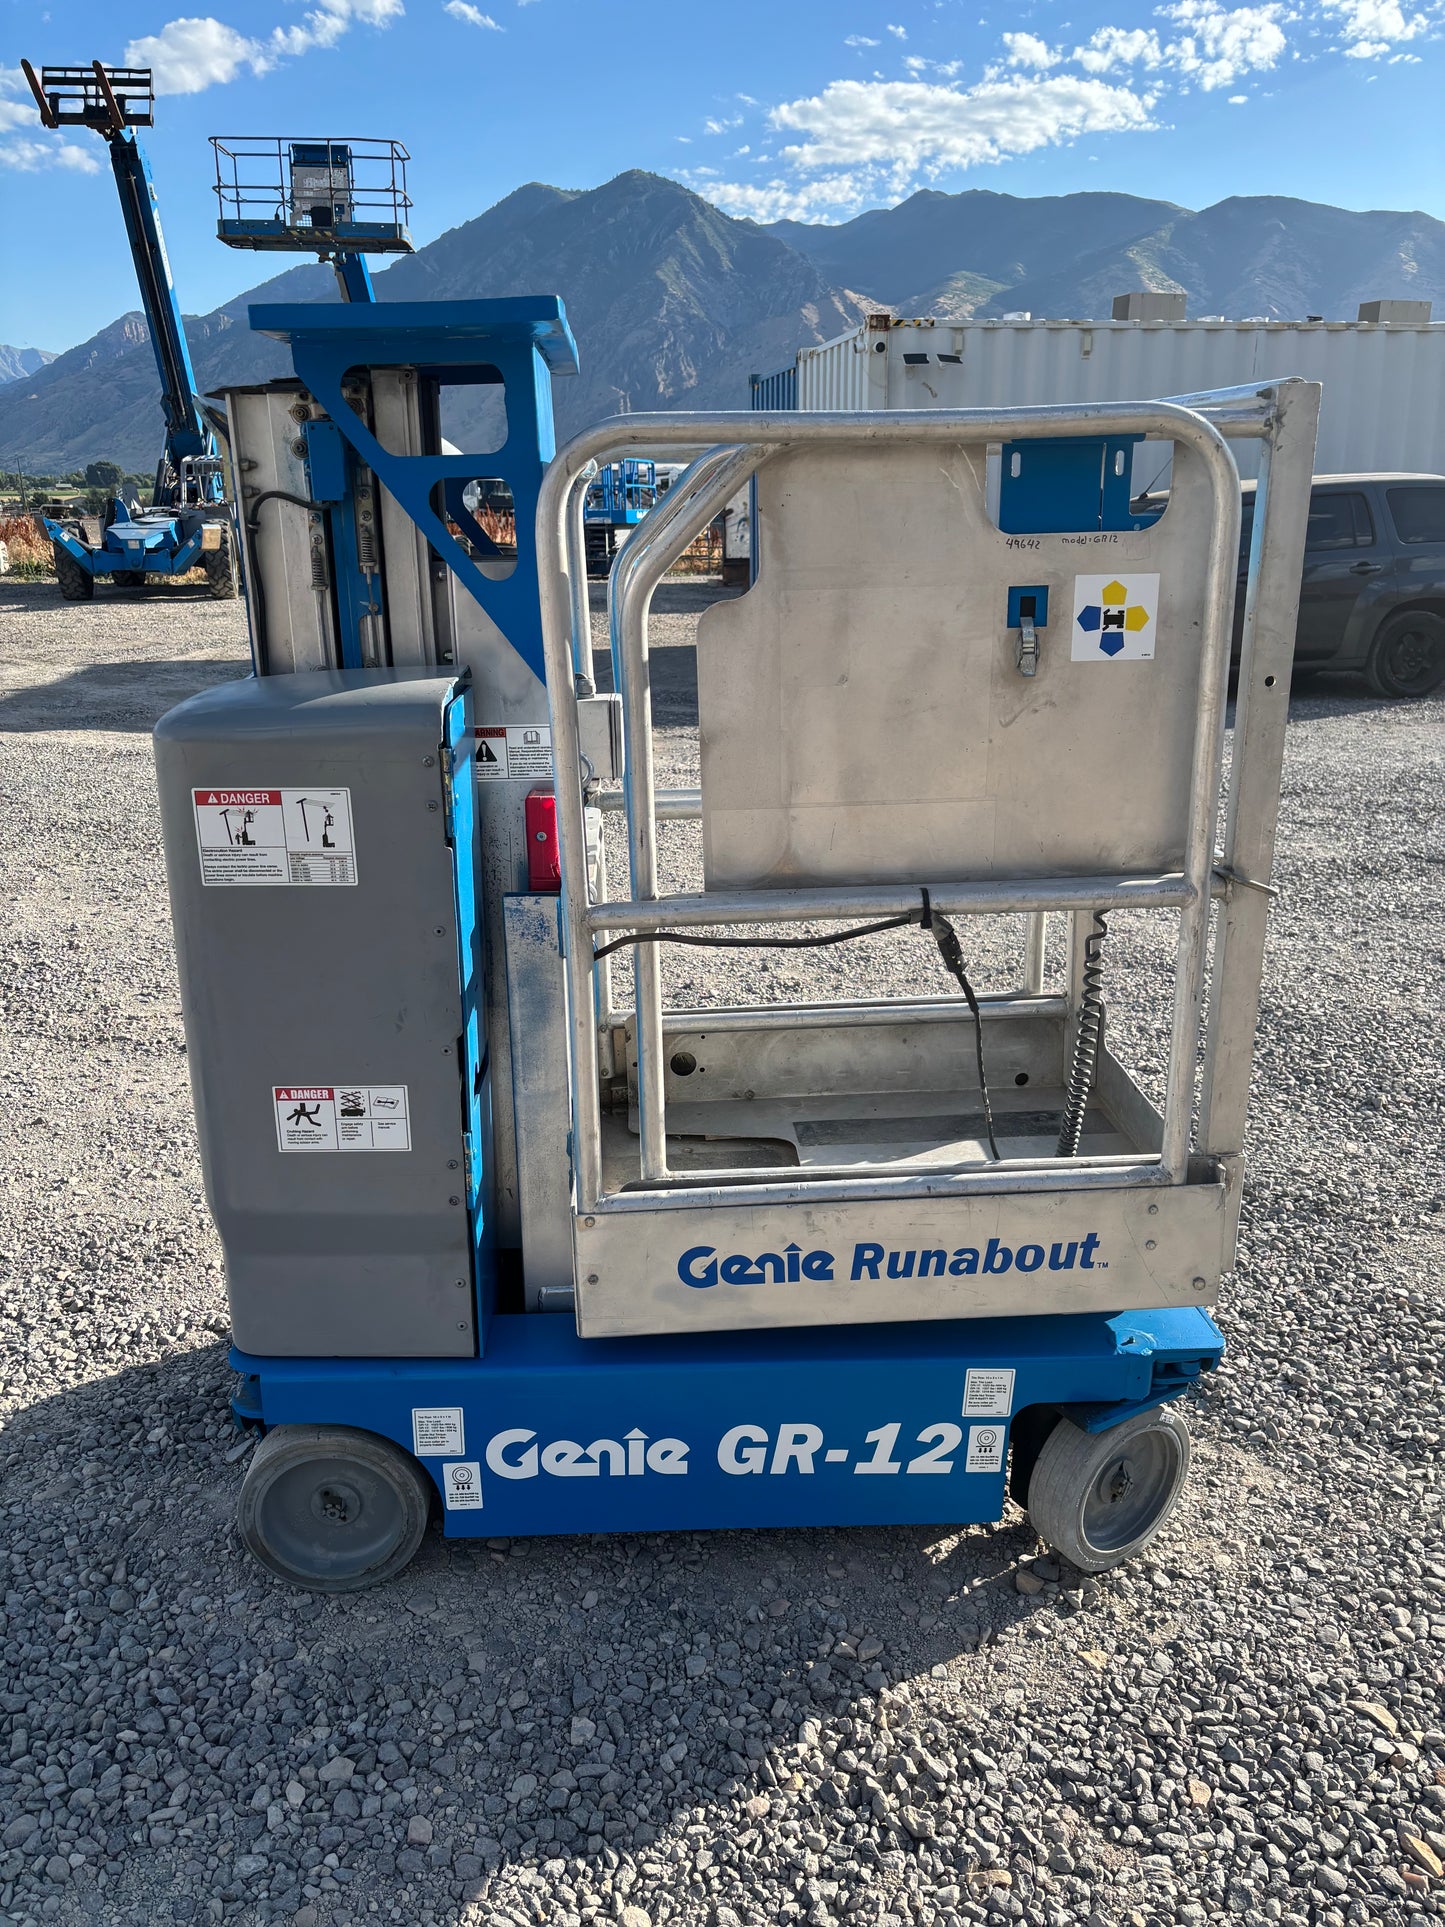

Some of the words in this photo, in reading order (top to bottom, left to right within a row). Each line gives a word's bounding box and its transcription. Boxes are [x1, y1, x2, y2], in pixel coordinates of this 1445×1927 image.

[1006, 538, 1041, 550] 49642
[476, 728, 504, 737] ARNING
[220, 793, 270, 804] DANGER
[290, 1090, 329, 1099] DANGER
[678, 1242, 834, 1288] Genie
[850, 1232, 1100, 1280] Runabout
[486, 1428, 690, 1480] Genie
[717, 1422, 962, 1476] GR-12
